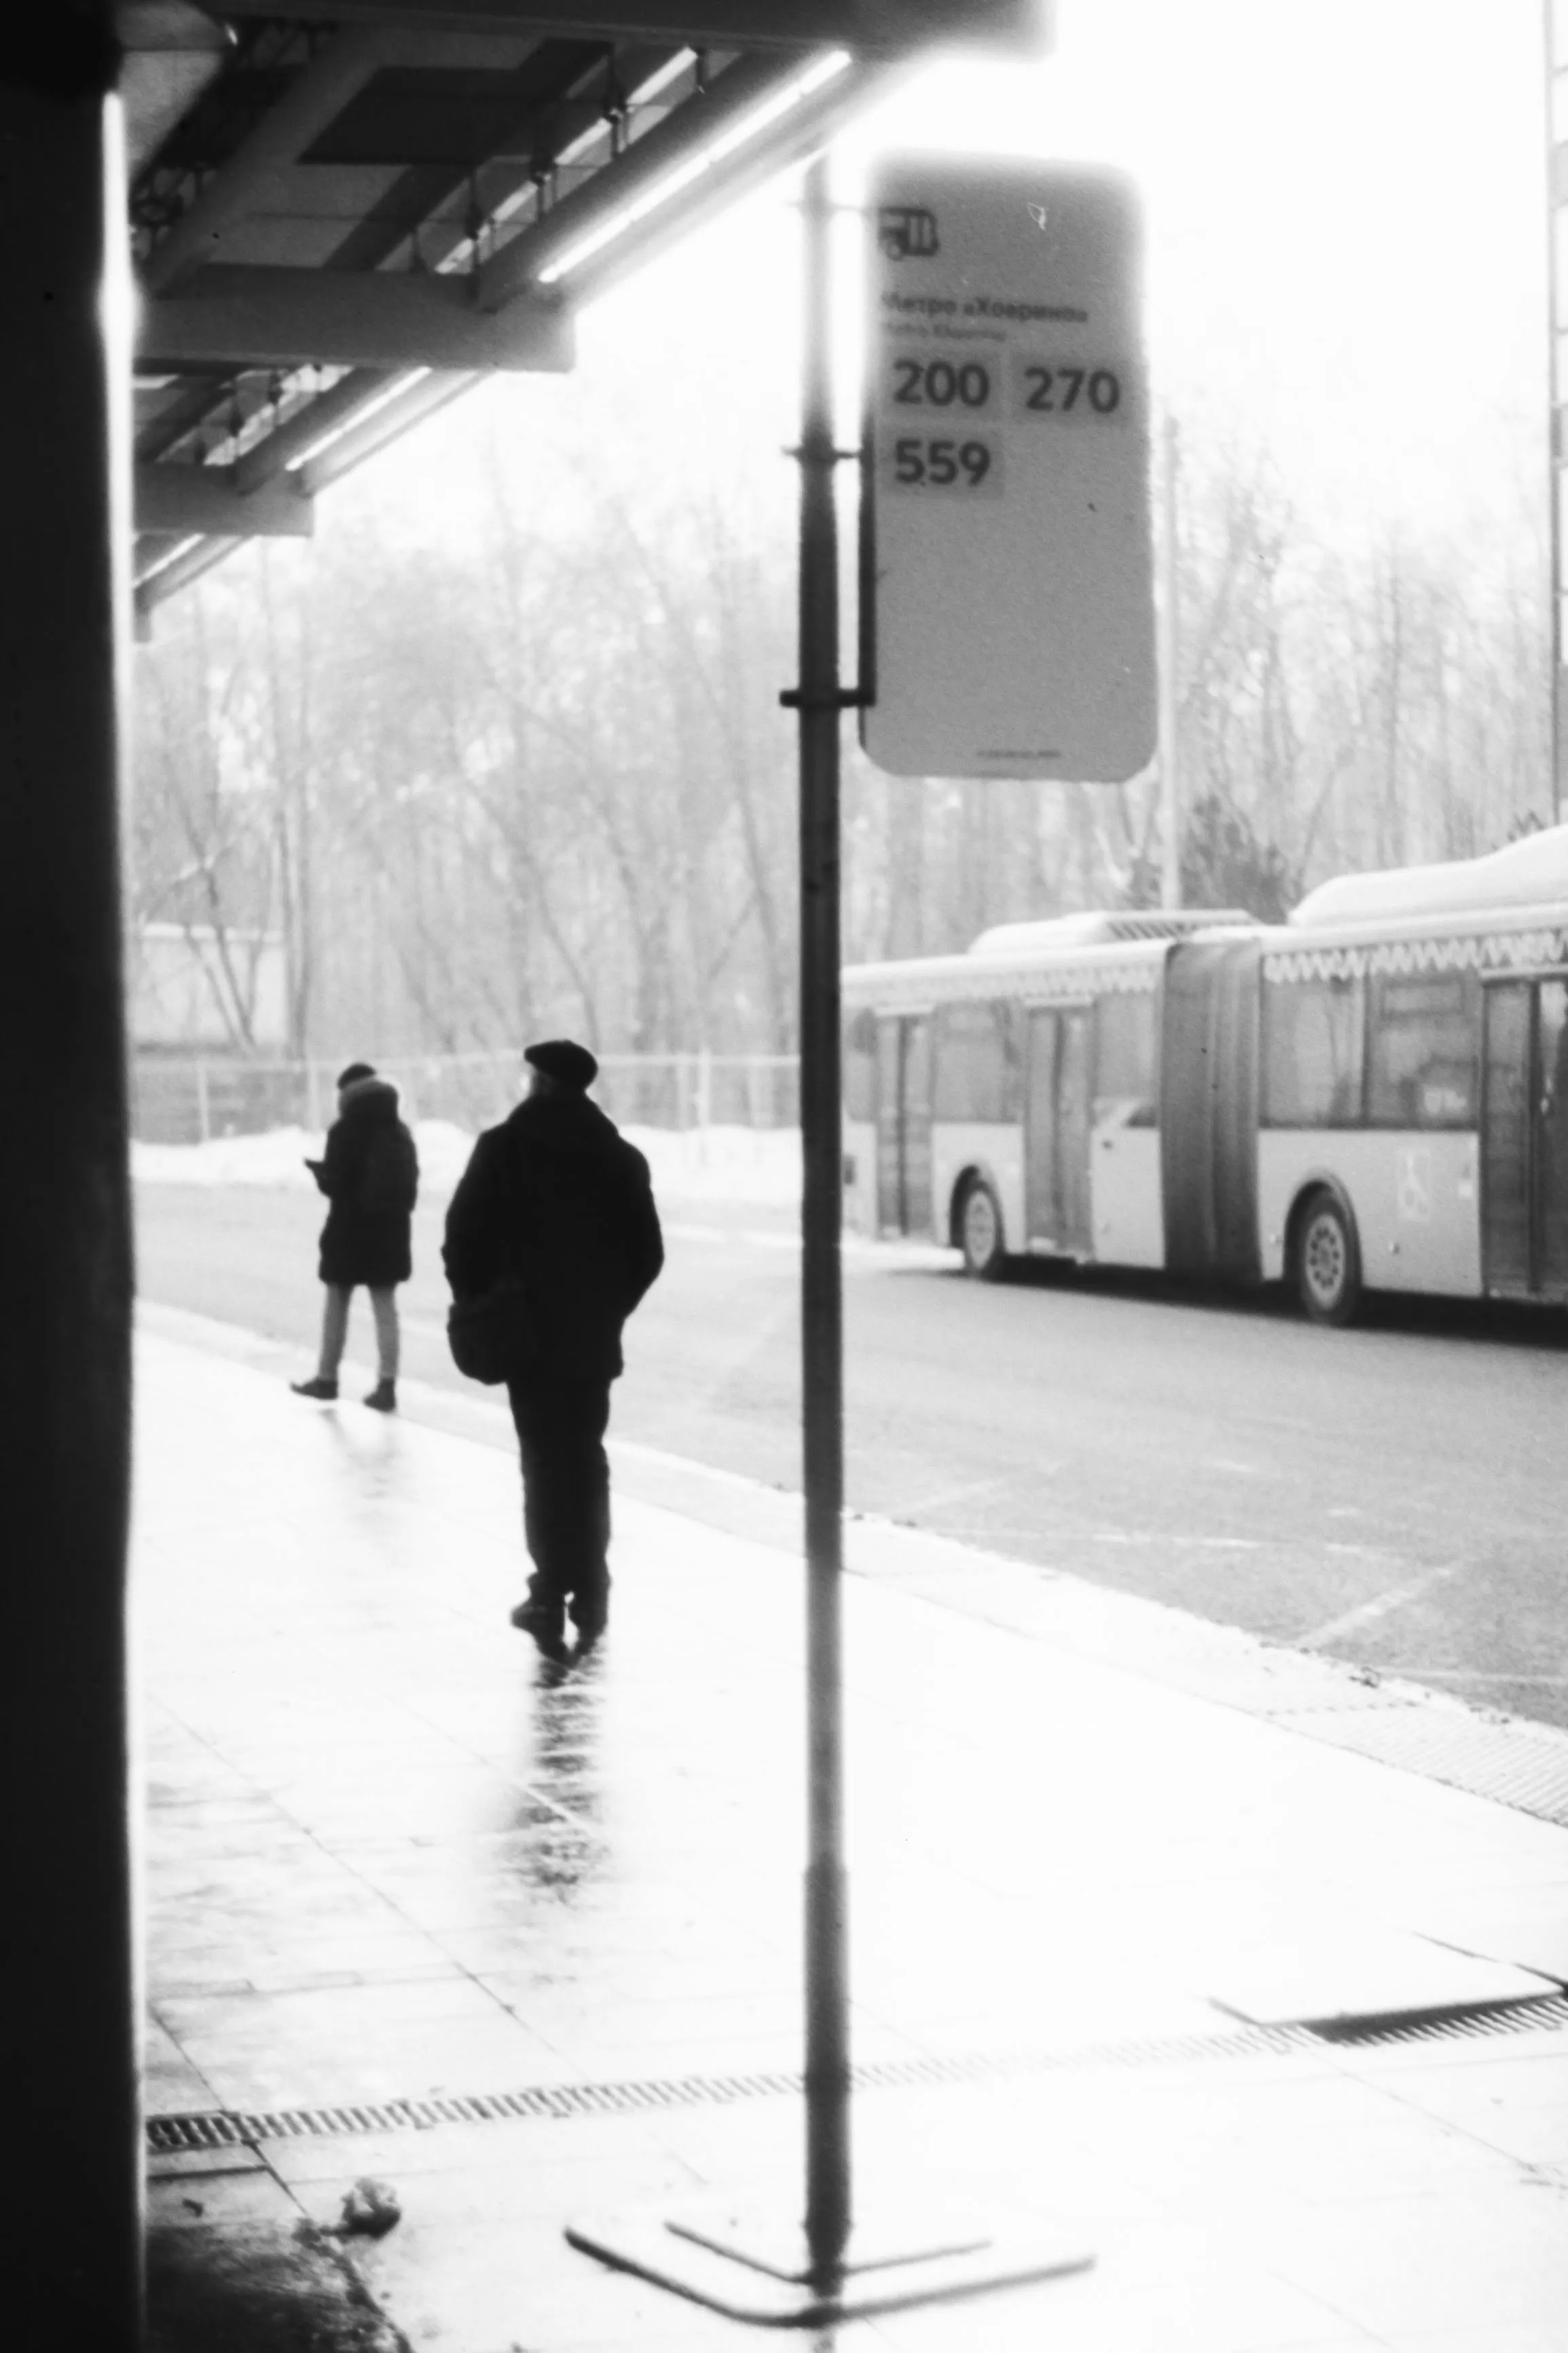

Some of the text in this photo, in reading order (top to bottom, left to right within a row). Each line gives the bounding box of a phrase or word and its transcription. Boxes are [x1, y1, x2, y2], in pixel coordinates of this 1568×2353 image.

[893, 358, 1119, 414] 200 270
[894, 438, 991, 486] 559
